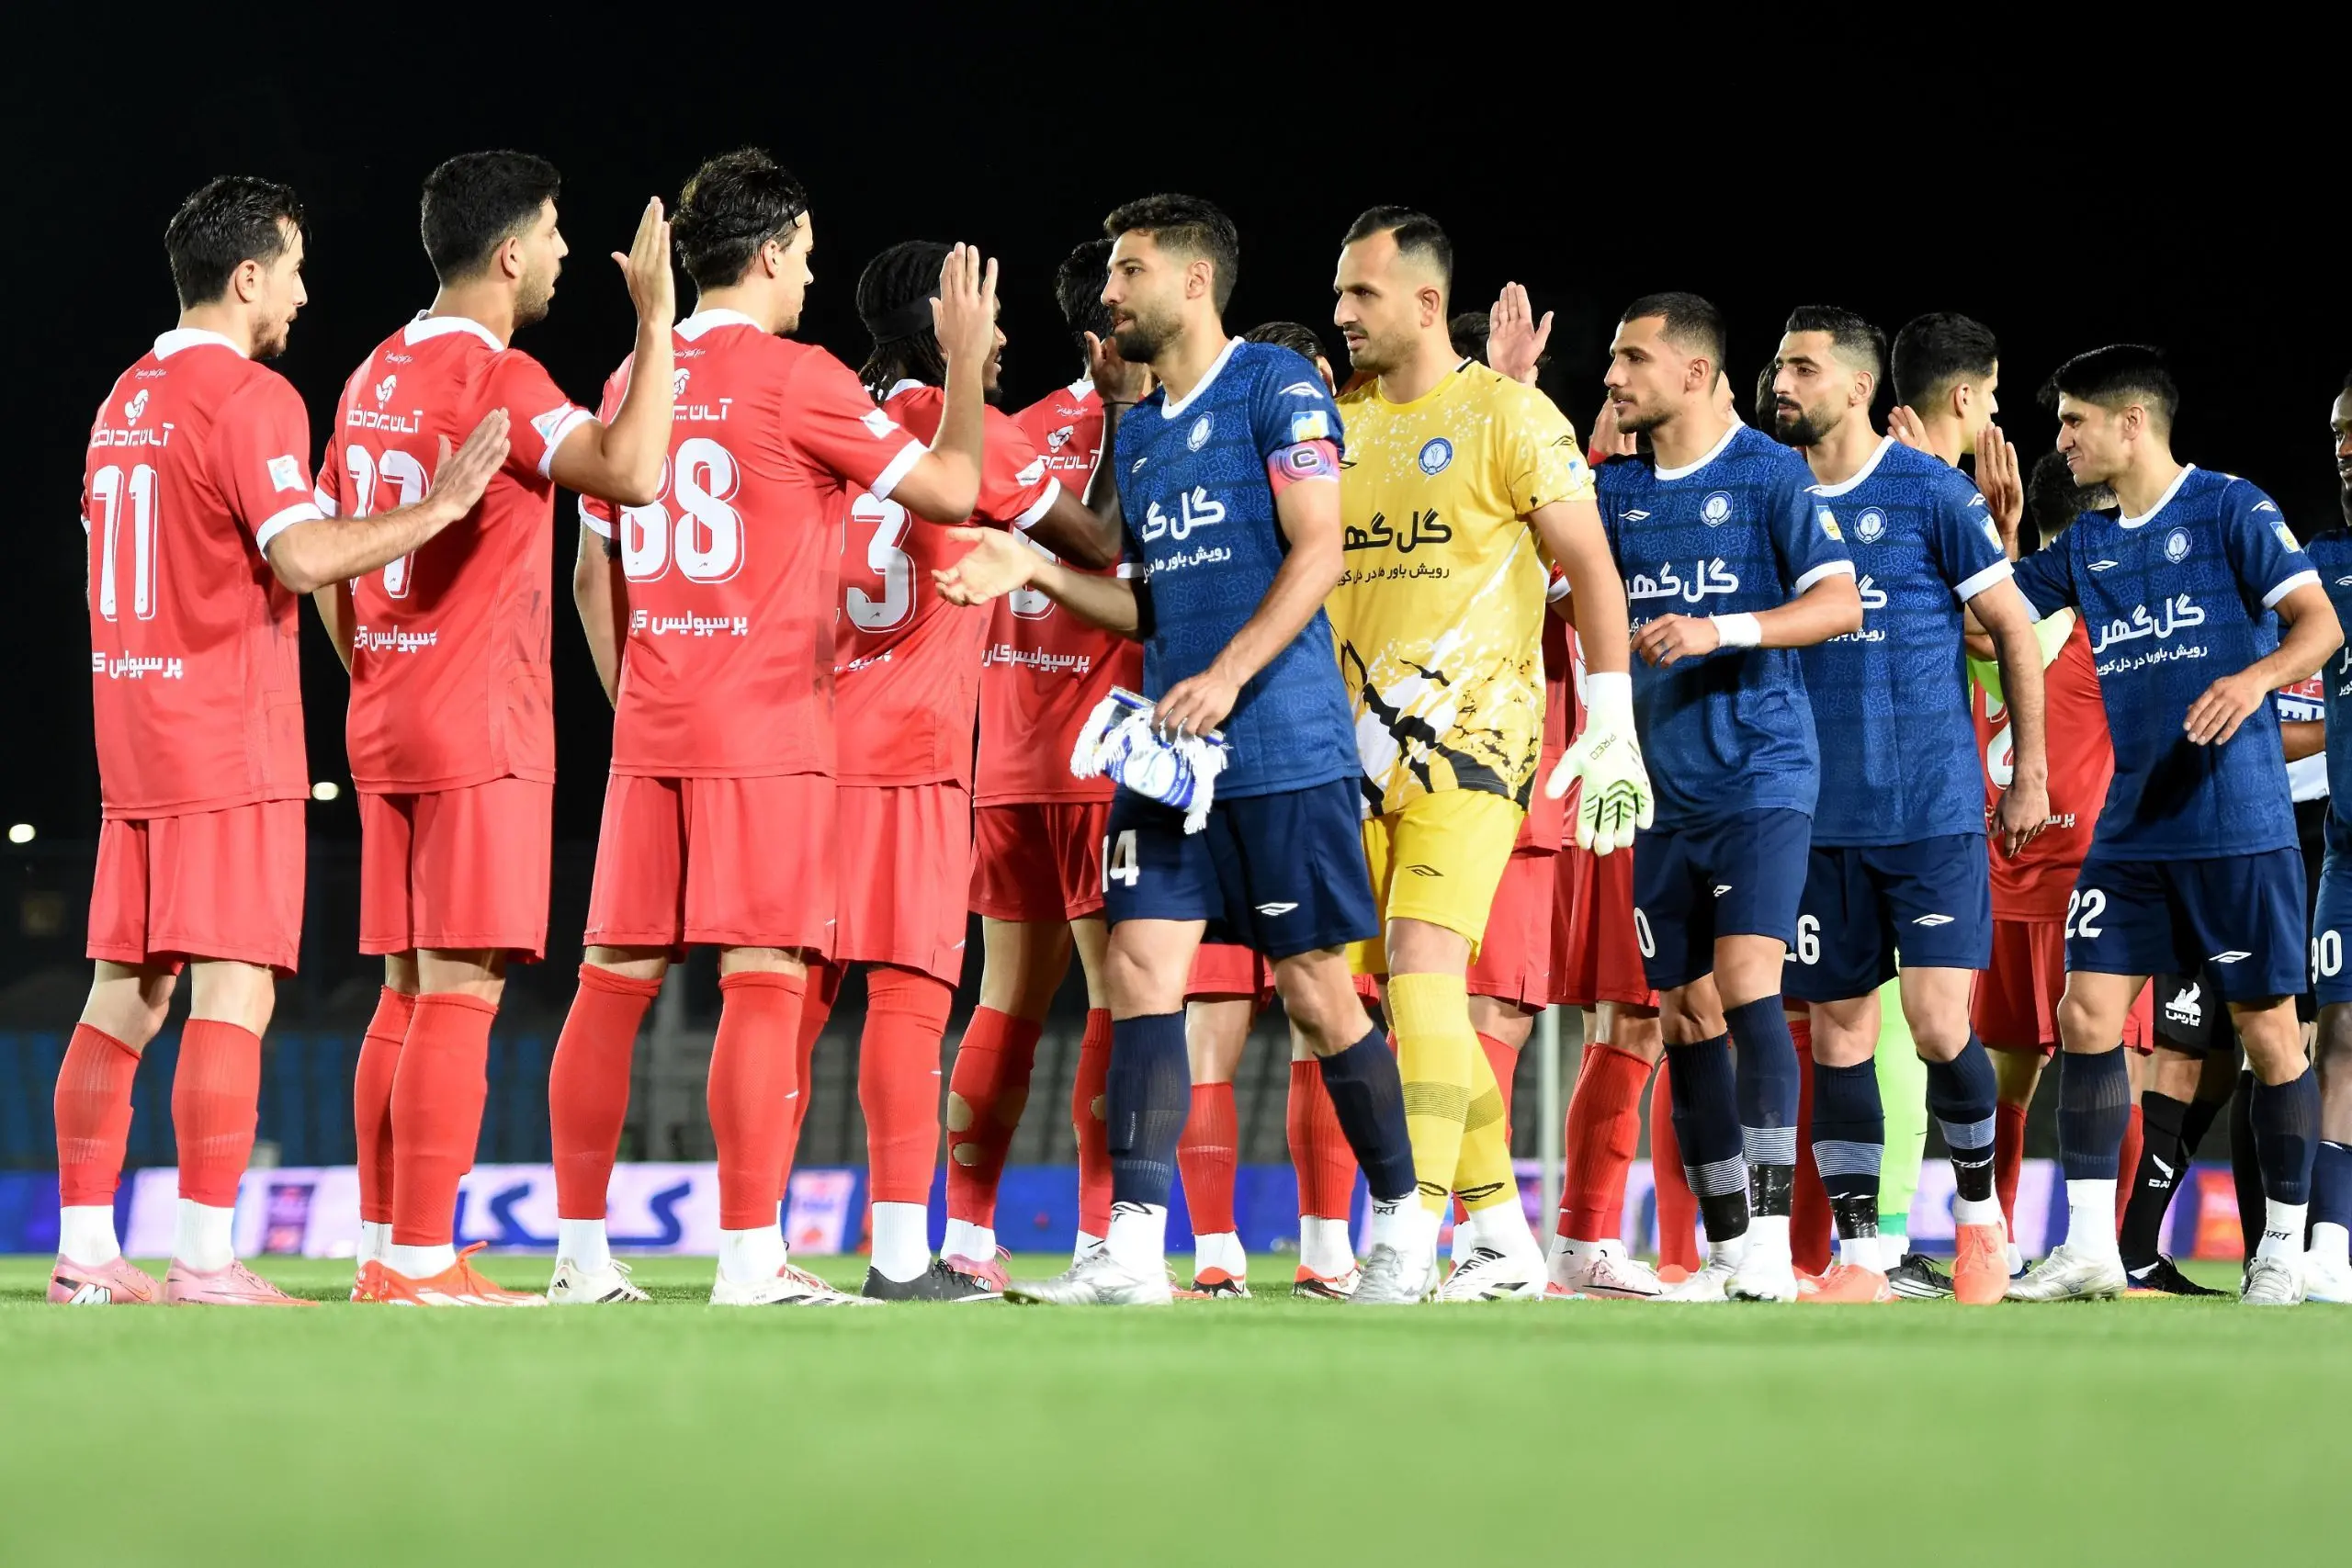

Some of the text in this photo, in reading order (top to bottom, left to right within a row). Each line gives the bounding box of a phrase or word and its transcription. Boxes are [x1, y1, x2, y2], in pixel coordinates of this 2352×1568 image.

[345, 402, 390, 430] پرداخ
[90, 422, 141, 448] پرداخ
[1292, 448, 1317, 468] C
[620, 437, 744, 583] 88
[1170, 485, 1226, 541] گل
[1342, 507, 1453, 554] گل گه
[843, 492, 916, 634] 3
[1188, 546, 1232, 566] رویش
[1408, 562, 1450, 579] رویش
[1682, 557, 1740, 604] گل
[1858, 574, 1888, 609] گ
[650, 610, 749, 637] پرسپولیس
[1850, 626, 1885, 642] رویش
[2092, 592, 2206, 654] گل گهر
[981, 643, 1012, 668] کار
[2116, 658, 2132, 673] دل
[2169, 643, 2208, 660] رویش
[1102, 829, 1140, 893] 14
[2064, 888, 2107, 940] 22
[1784, 914, 1821, 965] 6
[2311, 930, 2343, 985] 90
[2165, 1010, 2201, 1027] پارس
